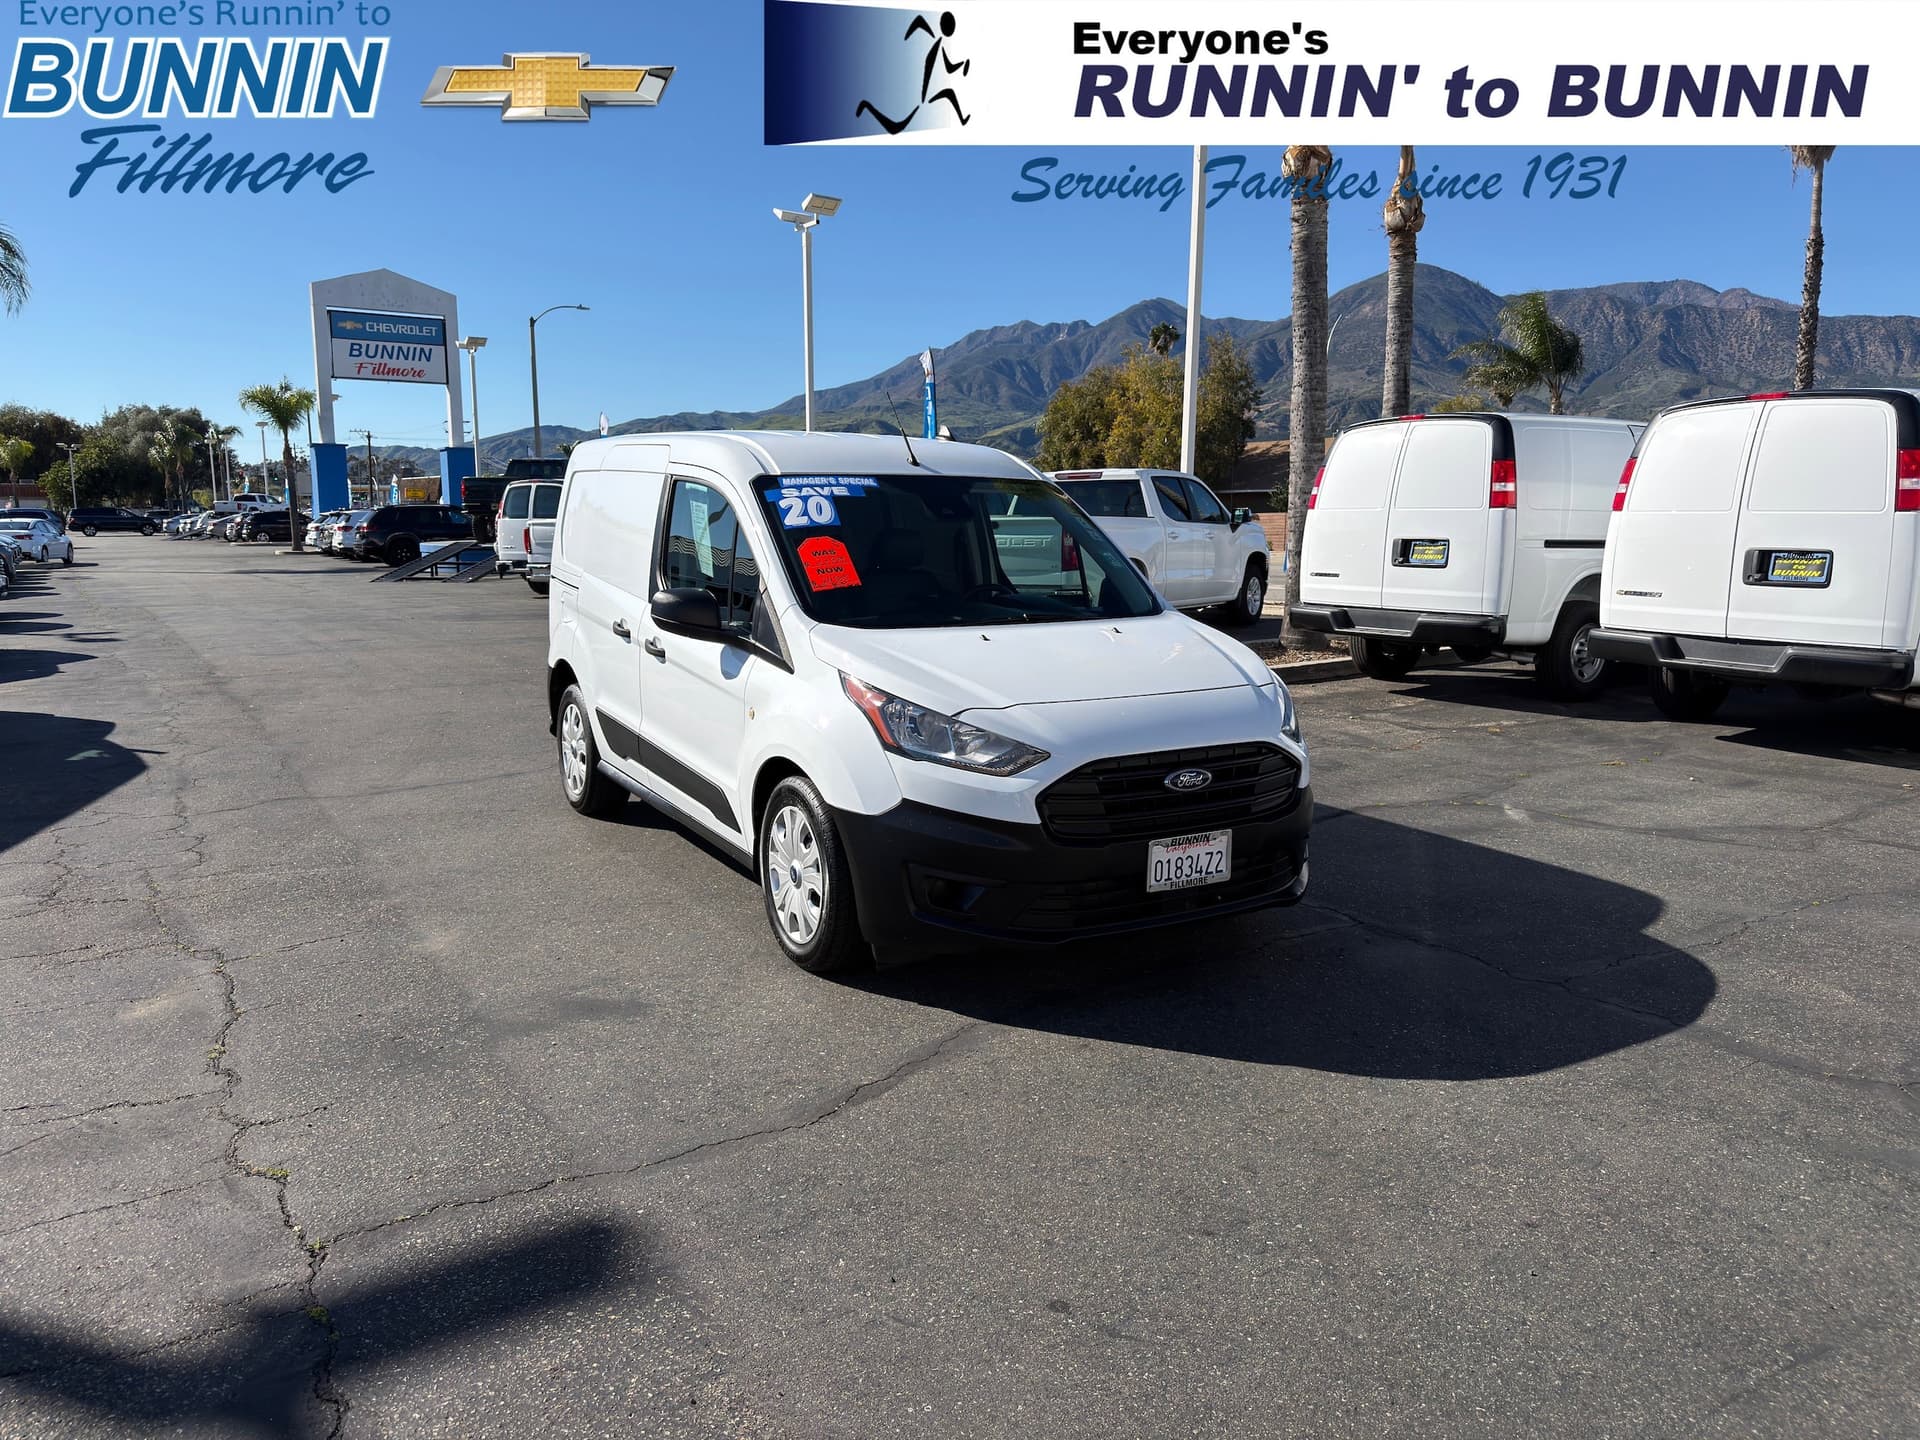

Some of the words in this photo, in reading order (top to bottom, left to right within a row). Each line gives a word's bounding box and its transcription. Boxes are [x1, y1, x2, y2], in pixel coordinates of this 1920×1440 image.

[365, 321, 438, 337] CHEVROLET
[348, 342, 433, 363] BUNNIN
[354, 362, 427, 378] Fillmore
[782, 477, 837, 486] MANAGER'S
[838, 477, 878, 487] SPECIAL
[780, 487, 850, 497] SAVE
[779, 496, 834, 526] 20
[816, 566, 844, 575] NOW
[1177, 772, 1203, 788] Ford
[1170, 833, 1211, 846] BUNNIN
[1154, 850, 1224, 883] 01834Z2
[1169, 876, 1209, 889] FILLMORE
